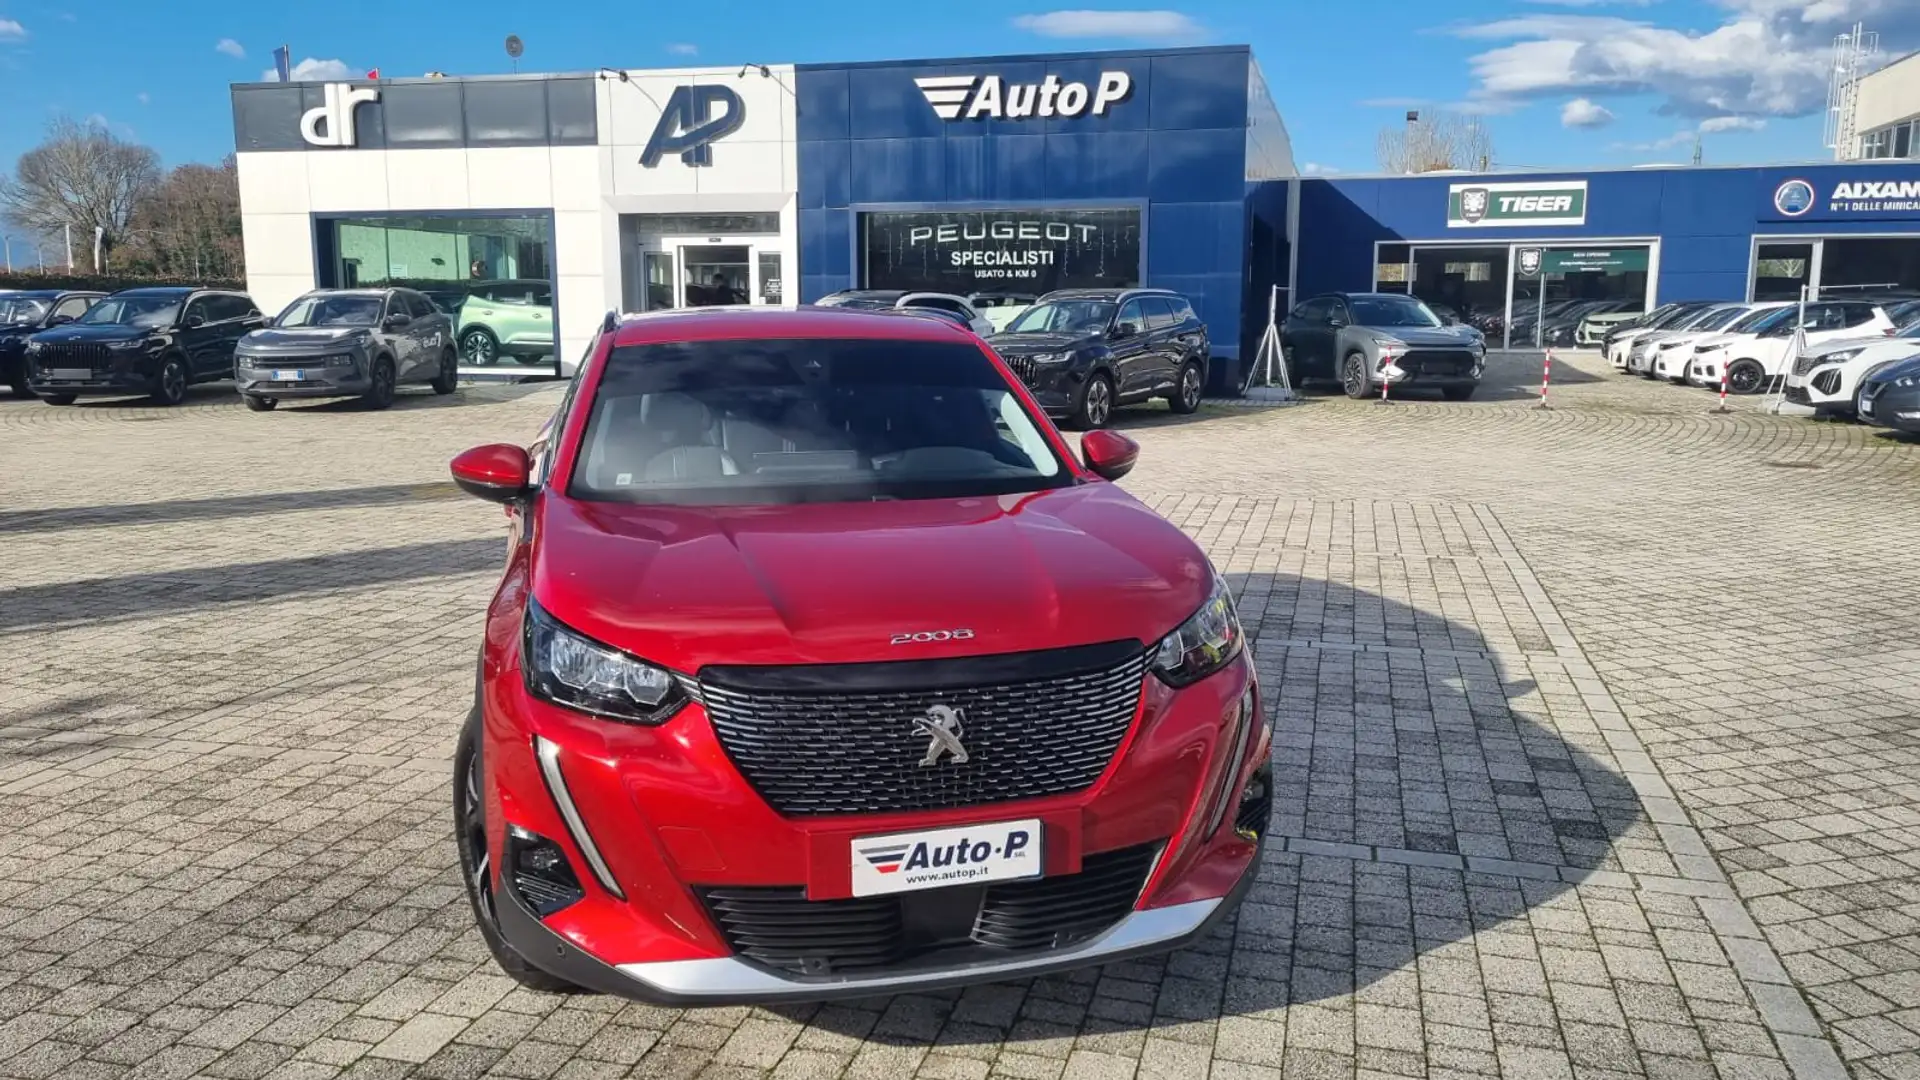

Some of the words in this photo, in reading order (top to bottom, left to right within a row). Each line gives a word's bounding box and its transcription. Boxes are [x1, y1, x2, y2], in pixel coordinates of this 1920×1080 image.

[966, 75, 1087, 117] Auto
[1092, 71, 1130, 115] P
[300, 83, 377, 146] dr
[638, 84, 745, 168] AP
[1831, 182, 1920, 199] AIXAM
[1498, 196, 1573, 213] TIGER
[1852, 202, 1881, 211] DELLE
[1883, 201, 1920, 211] MINICA
[910, 221, 1097, 246] PEUGEOT
[951, 251, 1054, 266] SPECIALISTI
[974, 269, 1005, 279] USATO
[1007, 270, 1014, 278] &
[1015, 270, 1030, 278] KM
[890, 628, 975, 645] 2008
[906, 866, 989, 884] www.autop.it
